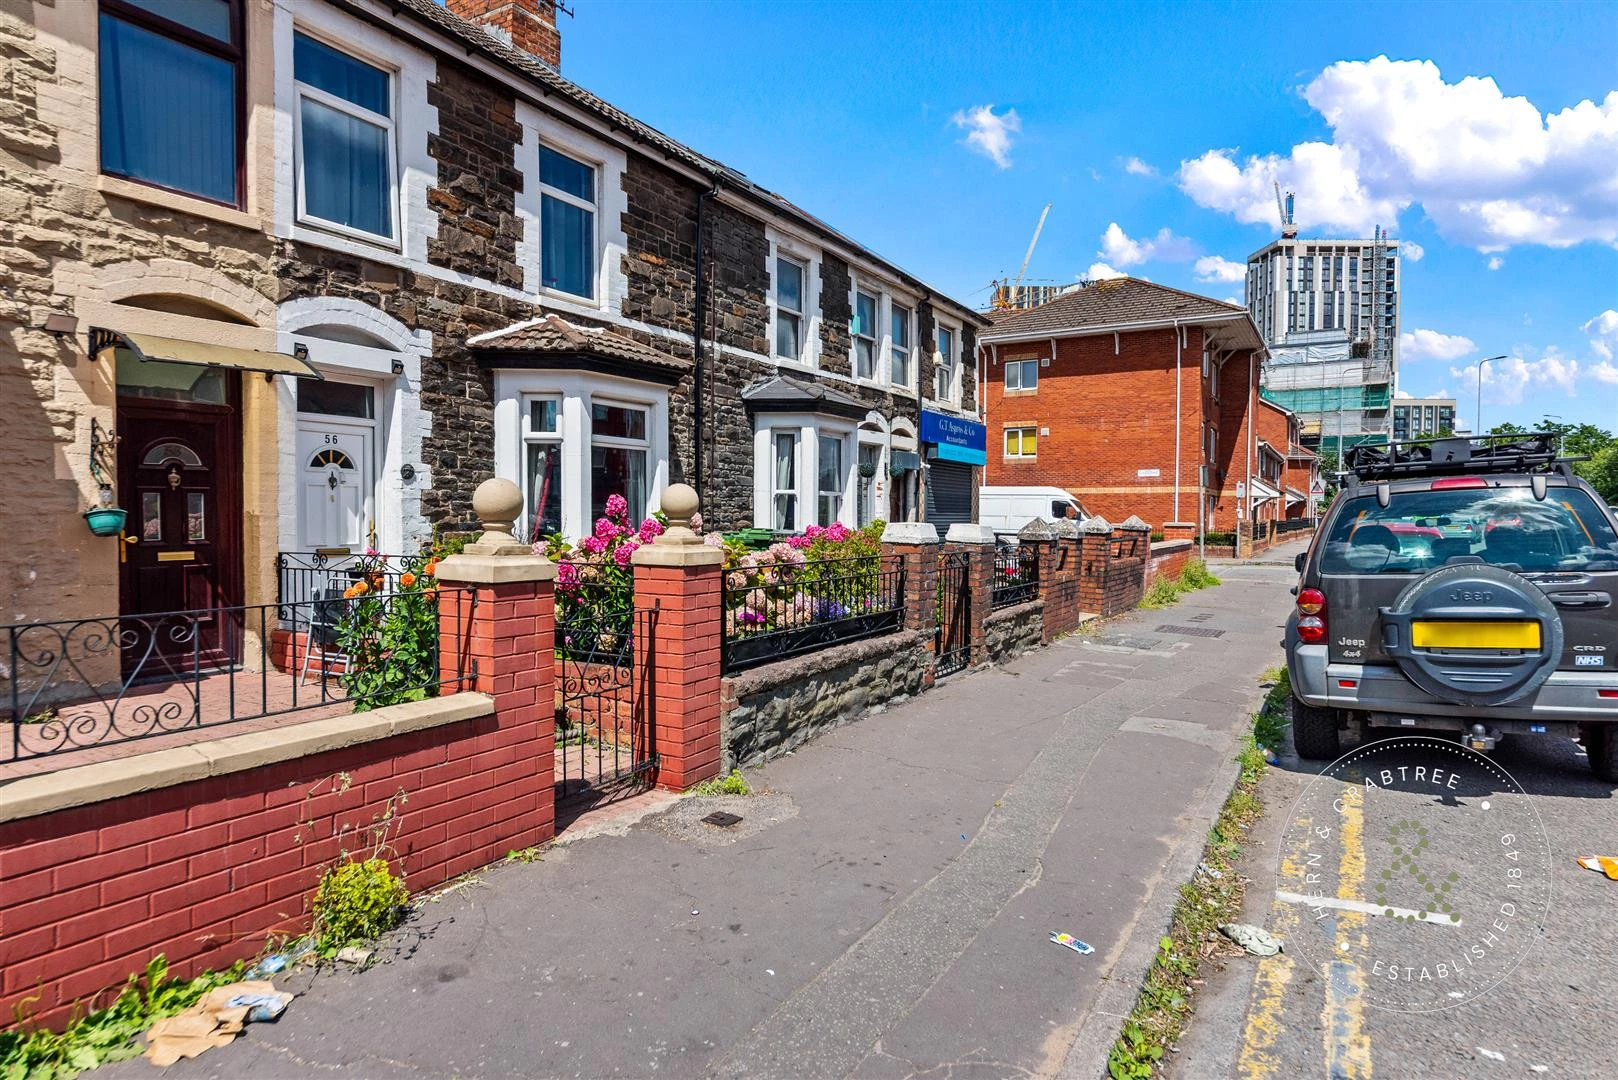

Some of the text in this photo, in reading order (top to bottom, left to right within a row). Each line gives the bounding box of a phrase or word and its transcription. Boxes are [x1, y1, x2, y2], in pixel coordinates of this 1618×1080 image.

[324, 434, 338, 445] 56
[946, 435, 968, 445] Accountants
[1449, 588, 1493, 604] Jeep
[1338, 636, 1366, 648] Jeep
[1343, 650, 1361, 658] 4x4
[1576, 656, 1602, 665] NHS
